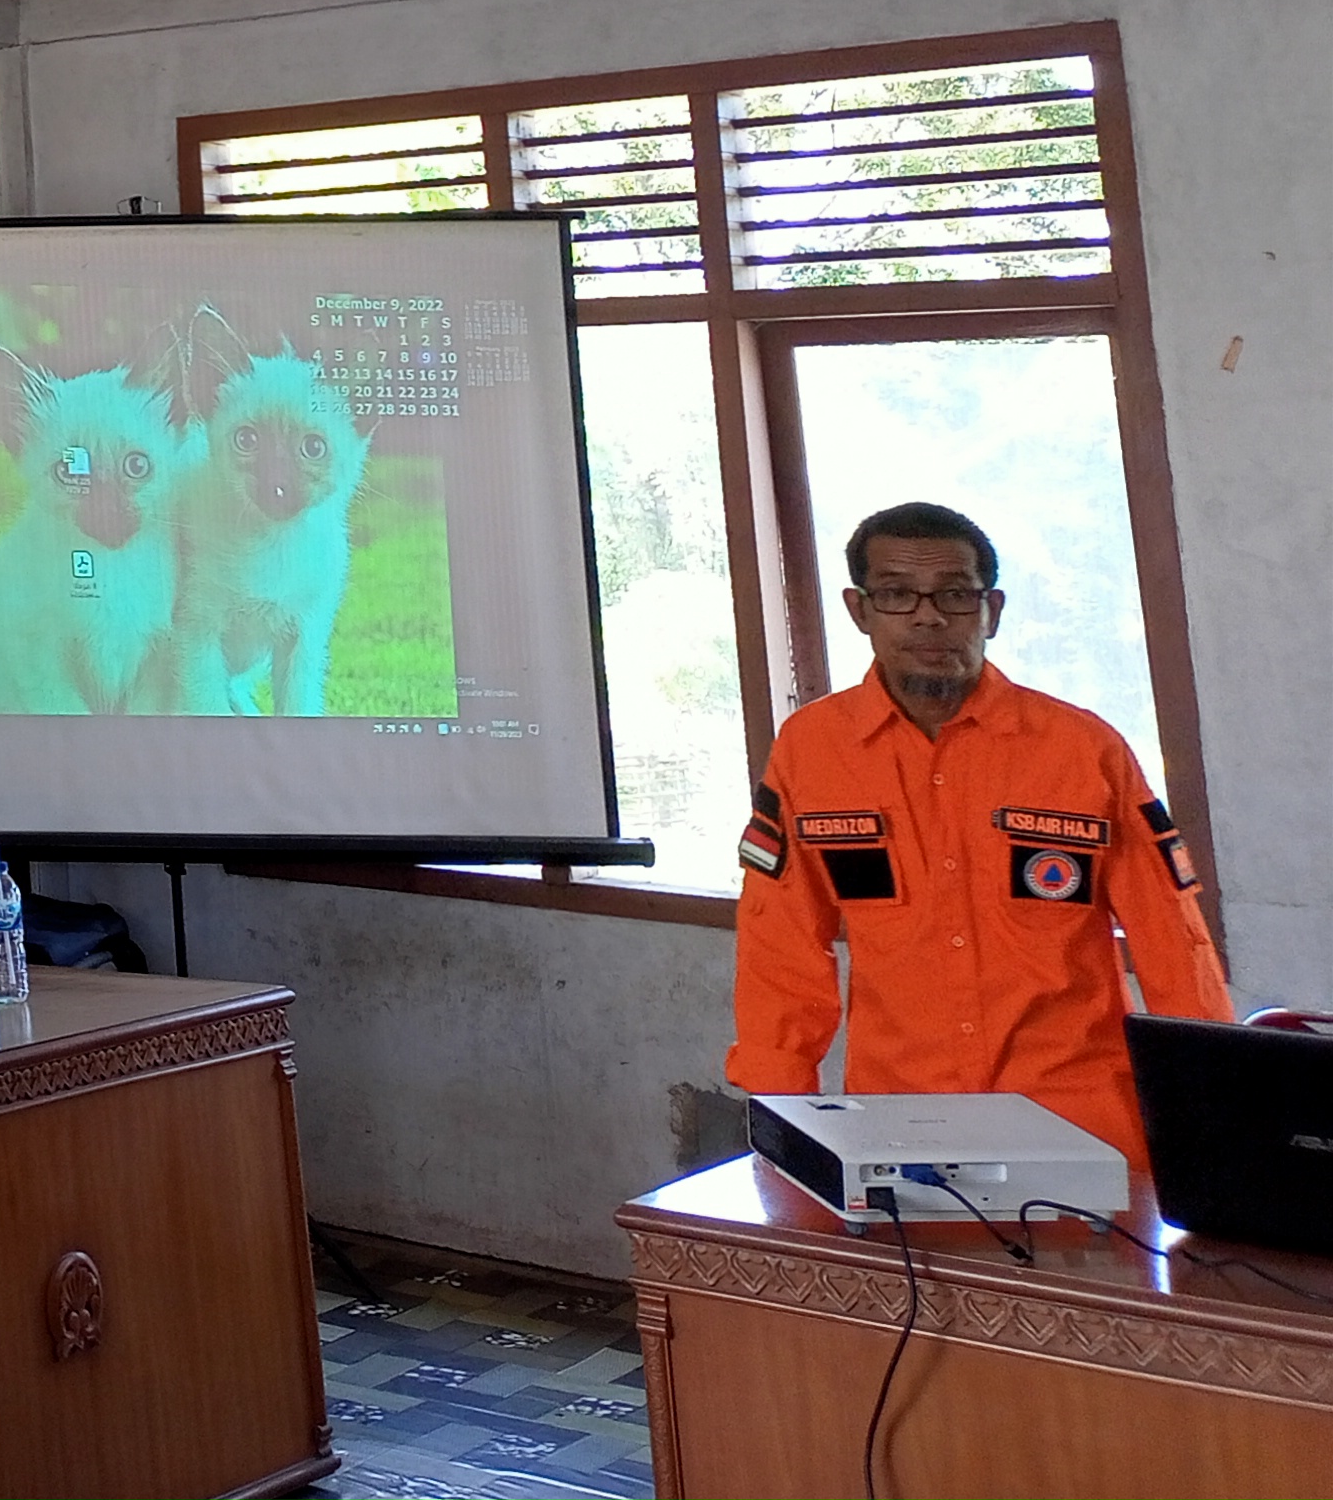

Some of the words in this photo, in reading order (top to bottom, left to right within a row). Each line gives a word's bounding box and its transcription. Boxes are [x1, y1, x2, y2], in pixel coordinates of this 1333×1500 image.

[315, 296, 387, 310] December
[408, 299, 444, 312] 2022
[310, 315, 320, 326] S
[331, 315, 343, 326] M
[353, 315, 364, 327] T
[373, 316, 389, 327] W
[397, 316, 408, 328] T
[420, 317, 429, 328] F
[441, 317, 452, 329] S
[400, 335, 409, 346] 1
[421, 335, 431, 346] 2
[442, 335, 452, 347] 3
[312, 350, 322, 360] 4
[334, 350, 344, 361] 5
[356, 350, 366, 362] 6
[378, 351, 387, 362] 7
[400, 352, 409, 363] 8
[421, 352, 431, 364] 9
[440, 352, 457, 364] 10
[332, 368, 349, 380] 12
[354, 369, 371, 380] 13
[376, 369, 393, 381] 14
[398, 370, 414, 381] 15
[419, 370, 437, 382] 16
[441, 370, 458, 382] 17
[355, 386, 372, 397] 20
[376, 387, 394, 398] 21
[398, 387, 416, 398] 22
[420, 388, 438, 399] 23
[442, 388, 459, 399] 24
[355, 403, 373, 415] 27
[377, 404, 395, 415] 28
[399, 404, 416, 416] 29
[421, 404, 439, 416] 30
[442, 405, 460, 417] 31
[1005, 811, 1035, 831] KSB
[1035, 815, 1062, 835] AIR
[1063, 819, 1100, 840] HAJI
